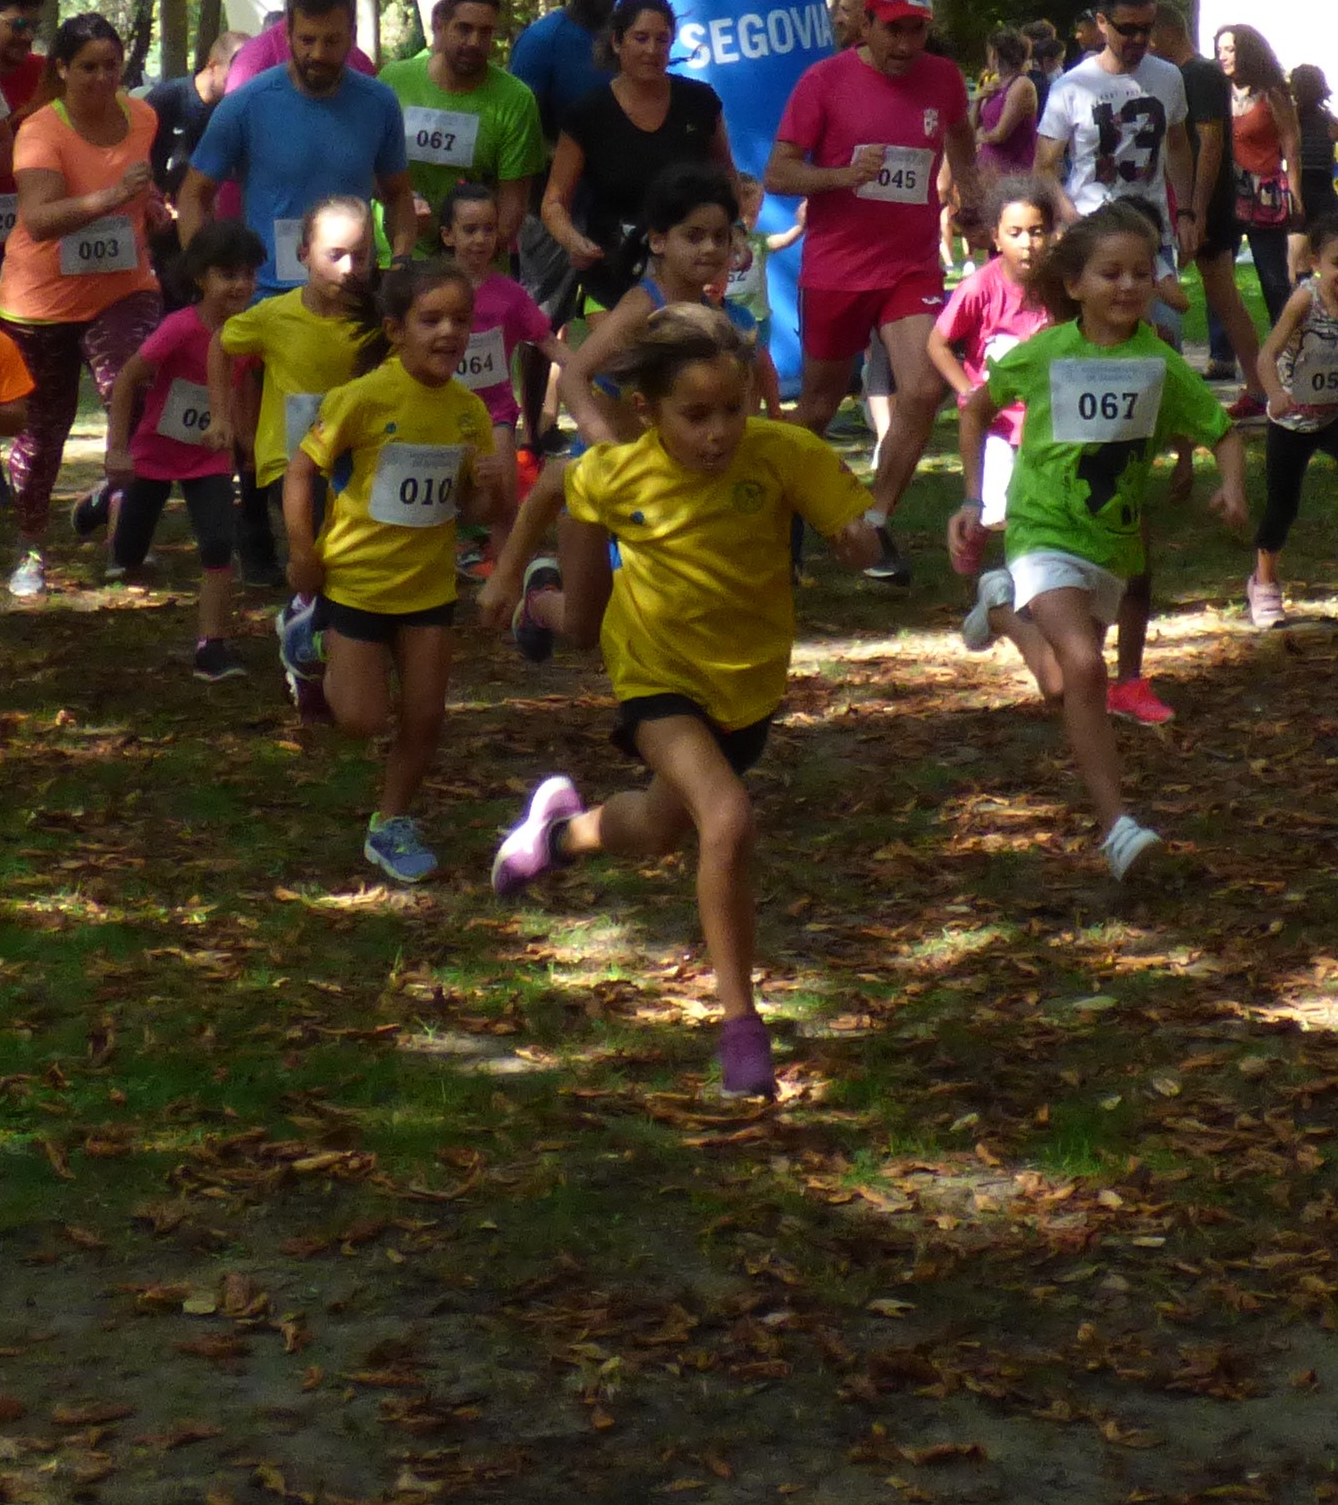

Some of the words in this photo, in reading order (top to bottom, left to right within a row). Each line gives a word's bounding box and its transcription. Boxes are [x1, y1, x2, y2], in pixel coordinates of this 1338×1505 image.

[678, 3, 834, 70] SEGOVIA
[416, 129, 456, 152] 067
[1091, 96, 1167, 184] 13
[877, 168, 917, 189] 045
[78, 239, 119, 260] 003
[456, 352, 494, 376] 064
[1078, 392, 1139, 421] 067
[182, 408, 212, 431] 06
[399, 477, 453, 506] 010
